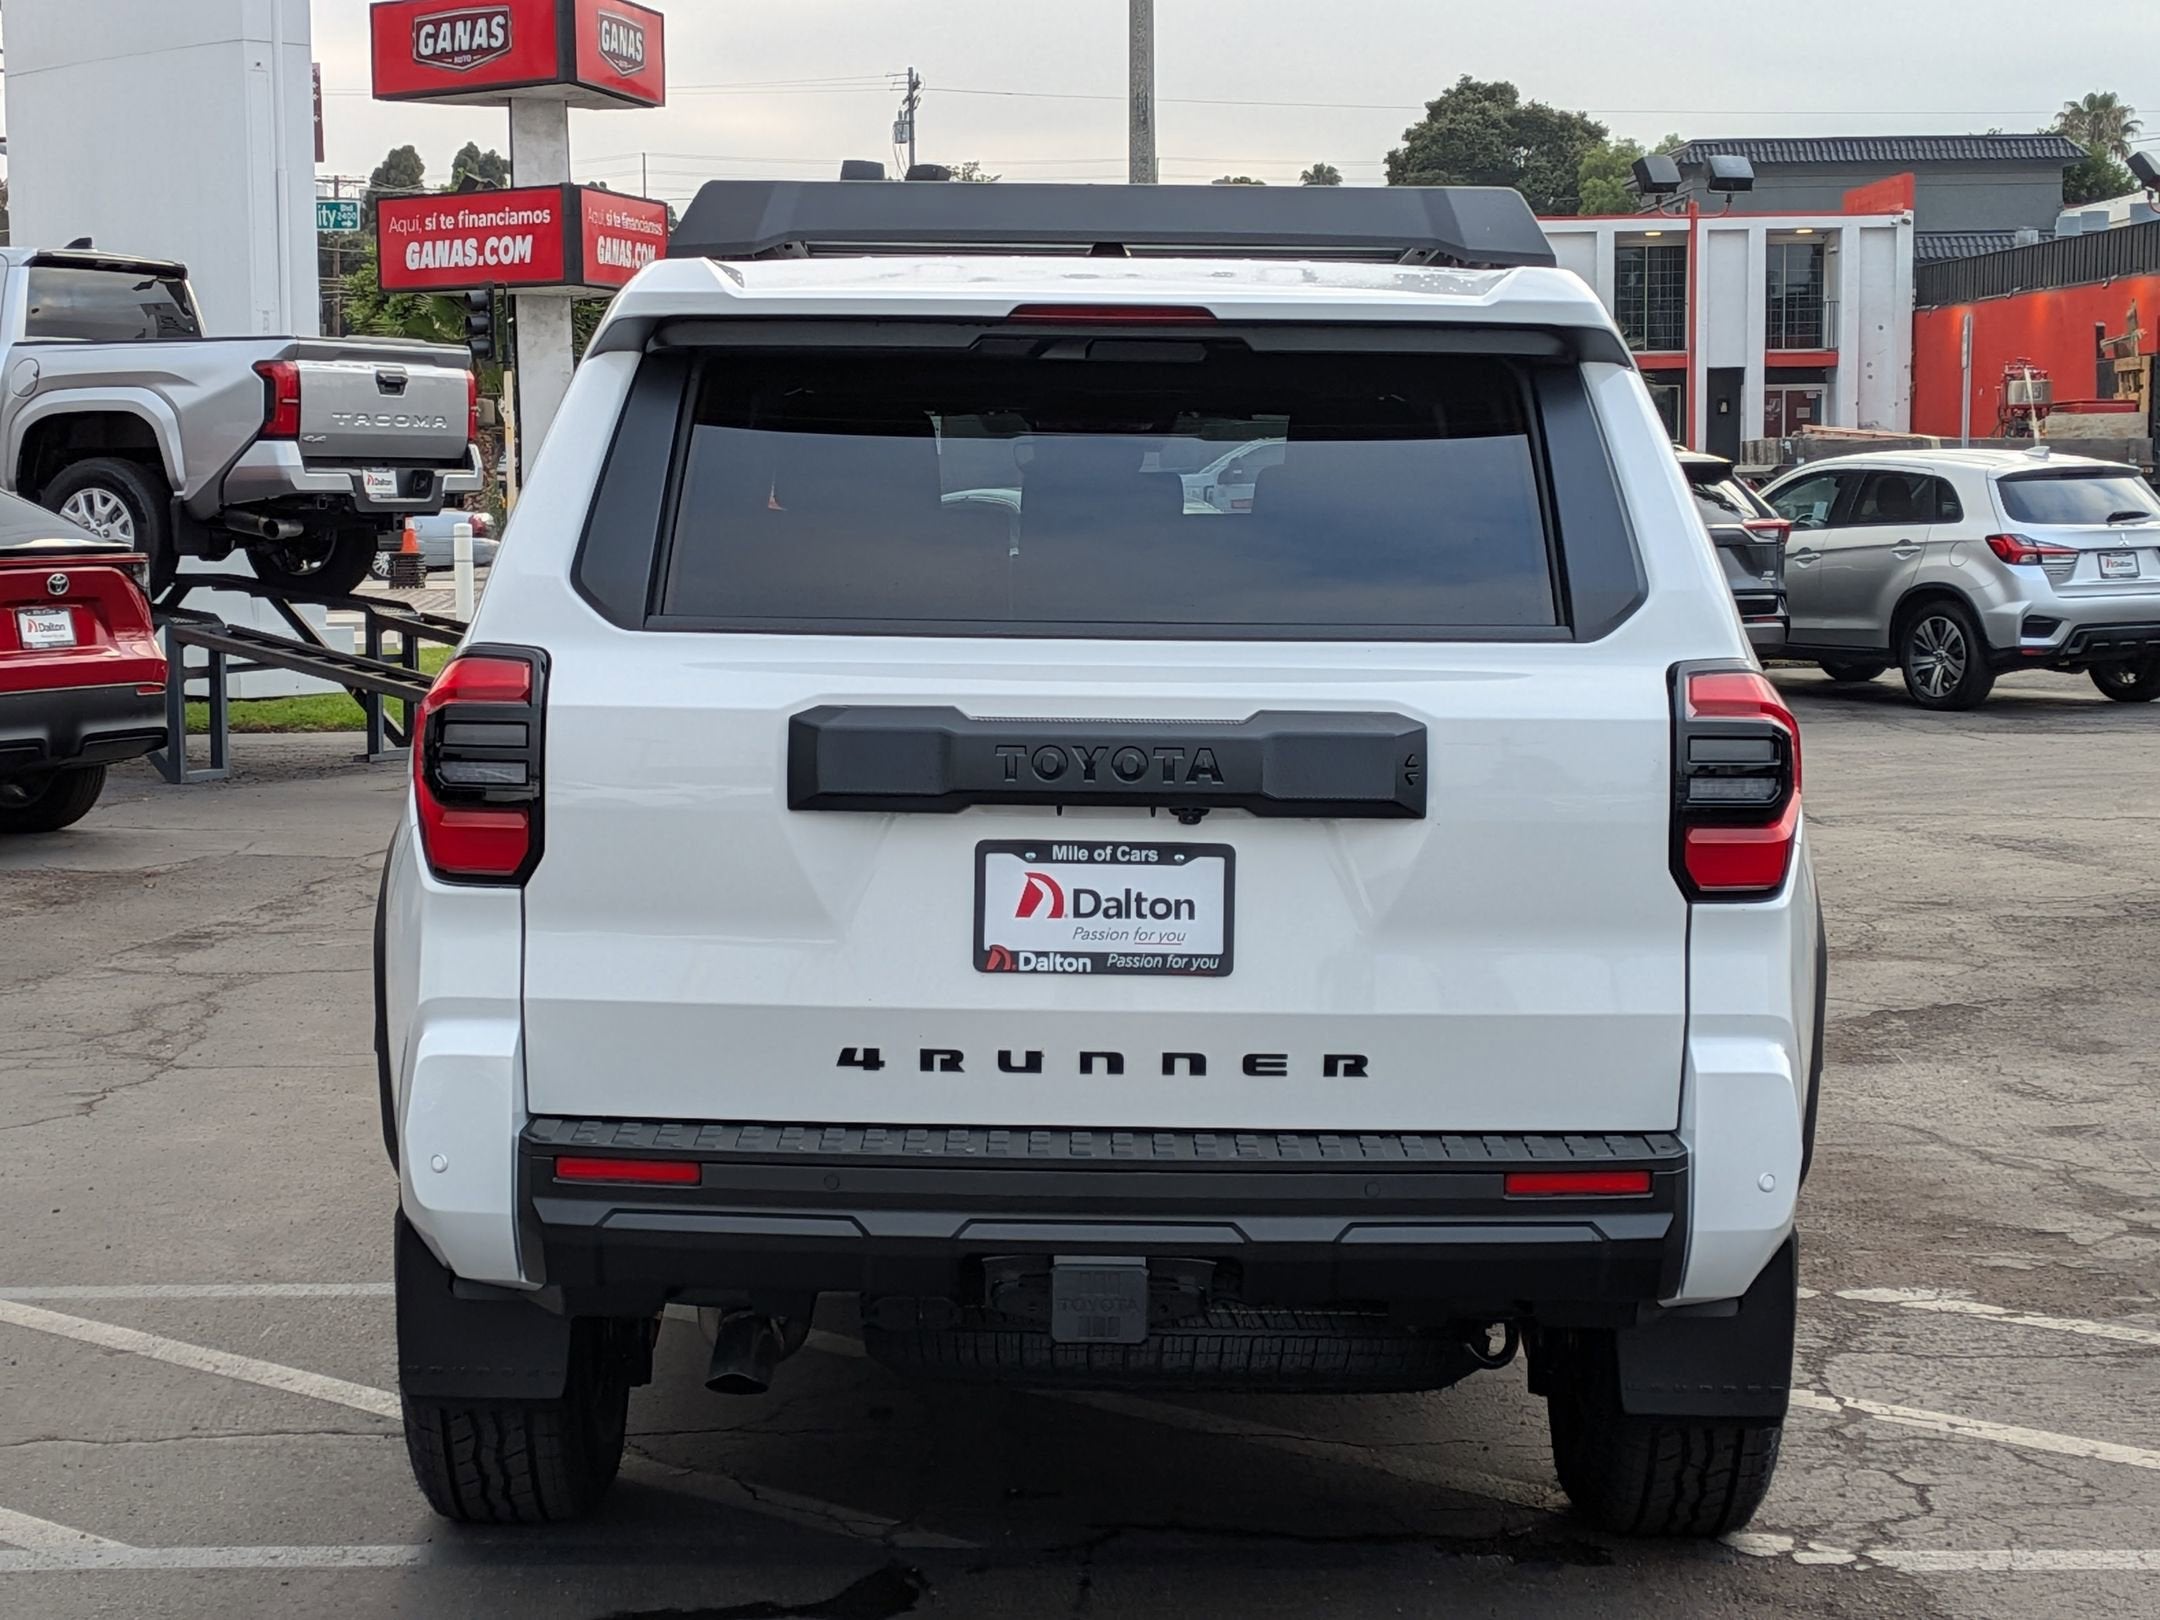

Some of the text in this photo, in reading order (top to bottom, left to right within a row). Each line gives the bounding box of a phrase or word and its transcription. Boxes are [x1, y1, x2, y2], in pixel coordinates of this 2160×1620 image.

[419, 15, 506, 56] GANAS
[602, 20, 643, 62] GANAS
[318, 204, 336, 228] ity
[424, 212, 437, 231] sí
[440, 213, 455, 230] te
[458, 207, 551, 229] financiamos
[406, 235, 533, 270] GANAS.COM
[332, 413, 447, 429] TACOMA
[38, 622, 66, 632] Dalton
[995, 744, 1224, 784] TOYOTA
[1052, 845, 1159, 862] Mile of Cars
[1073, 888, 1195, 920] Dalton
[1072, 927, 1187, 943] Passion for you
[1019, 952, 1219, 973] Dalton Passion for you
[836, 1047, 1369, 1078] 4RUNNER
